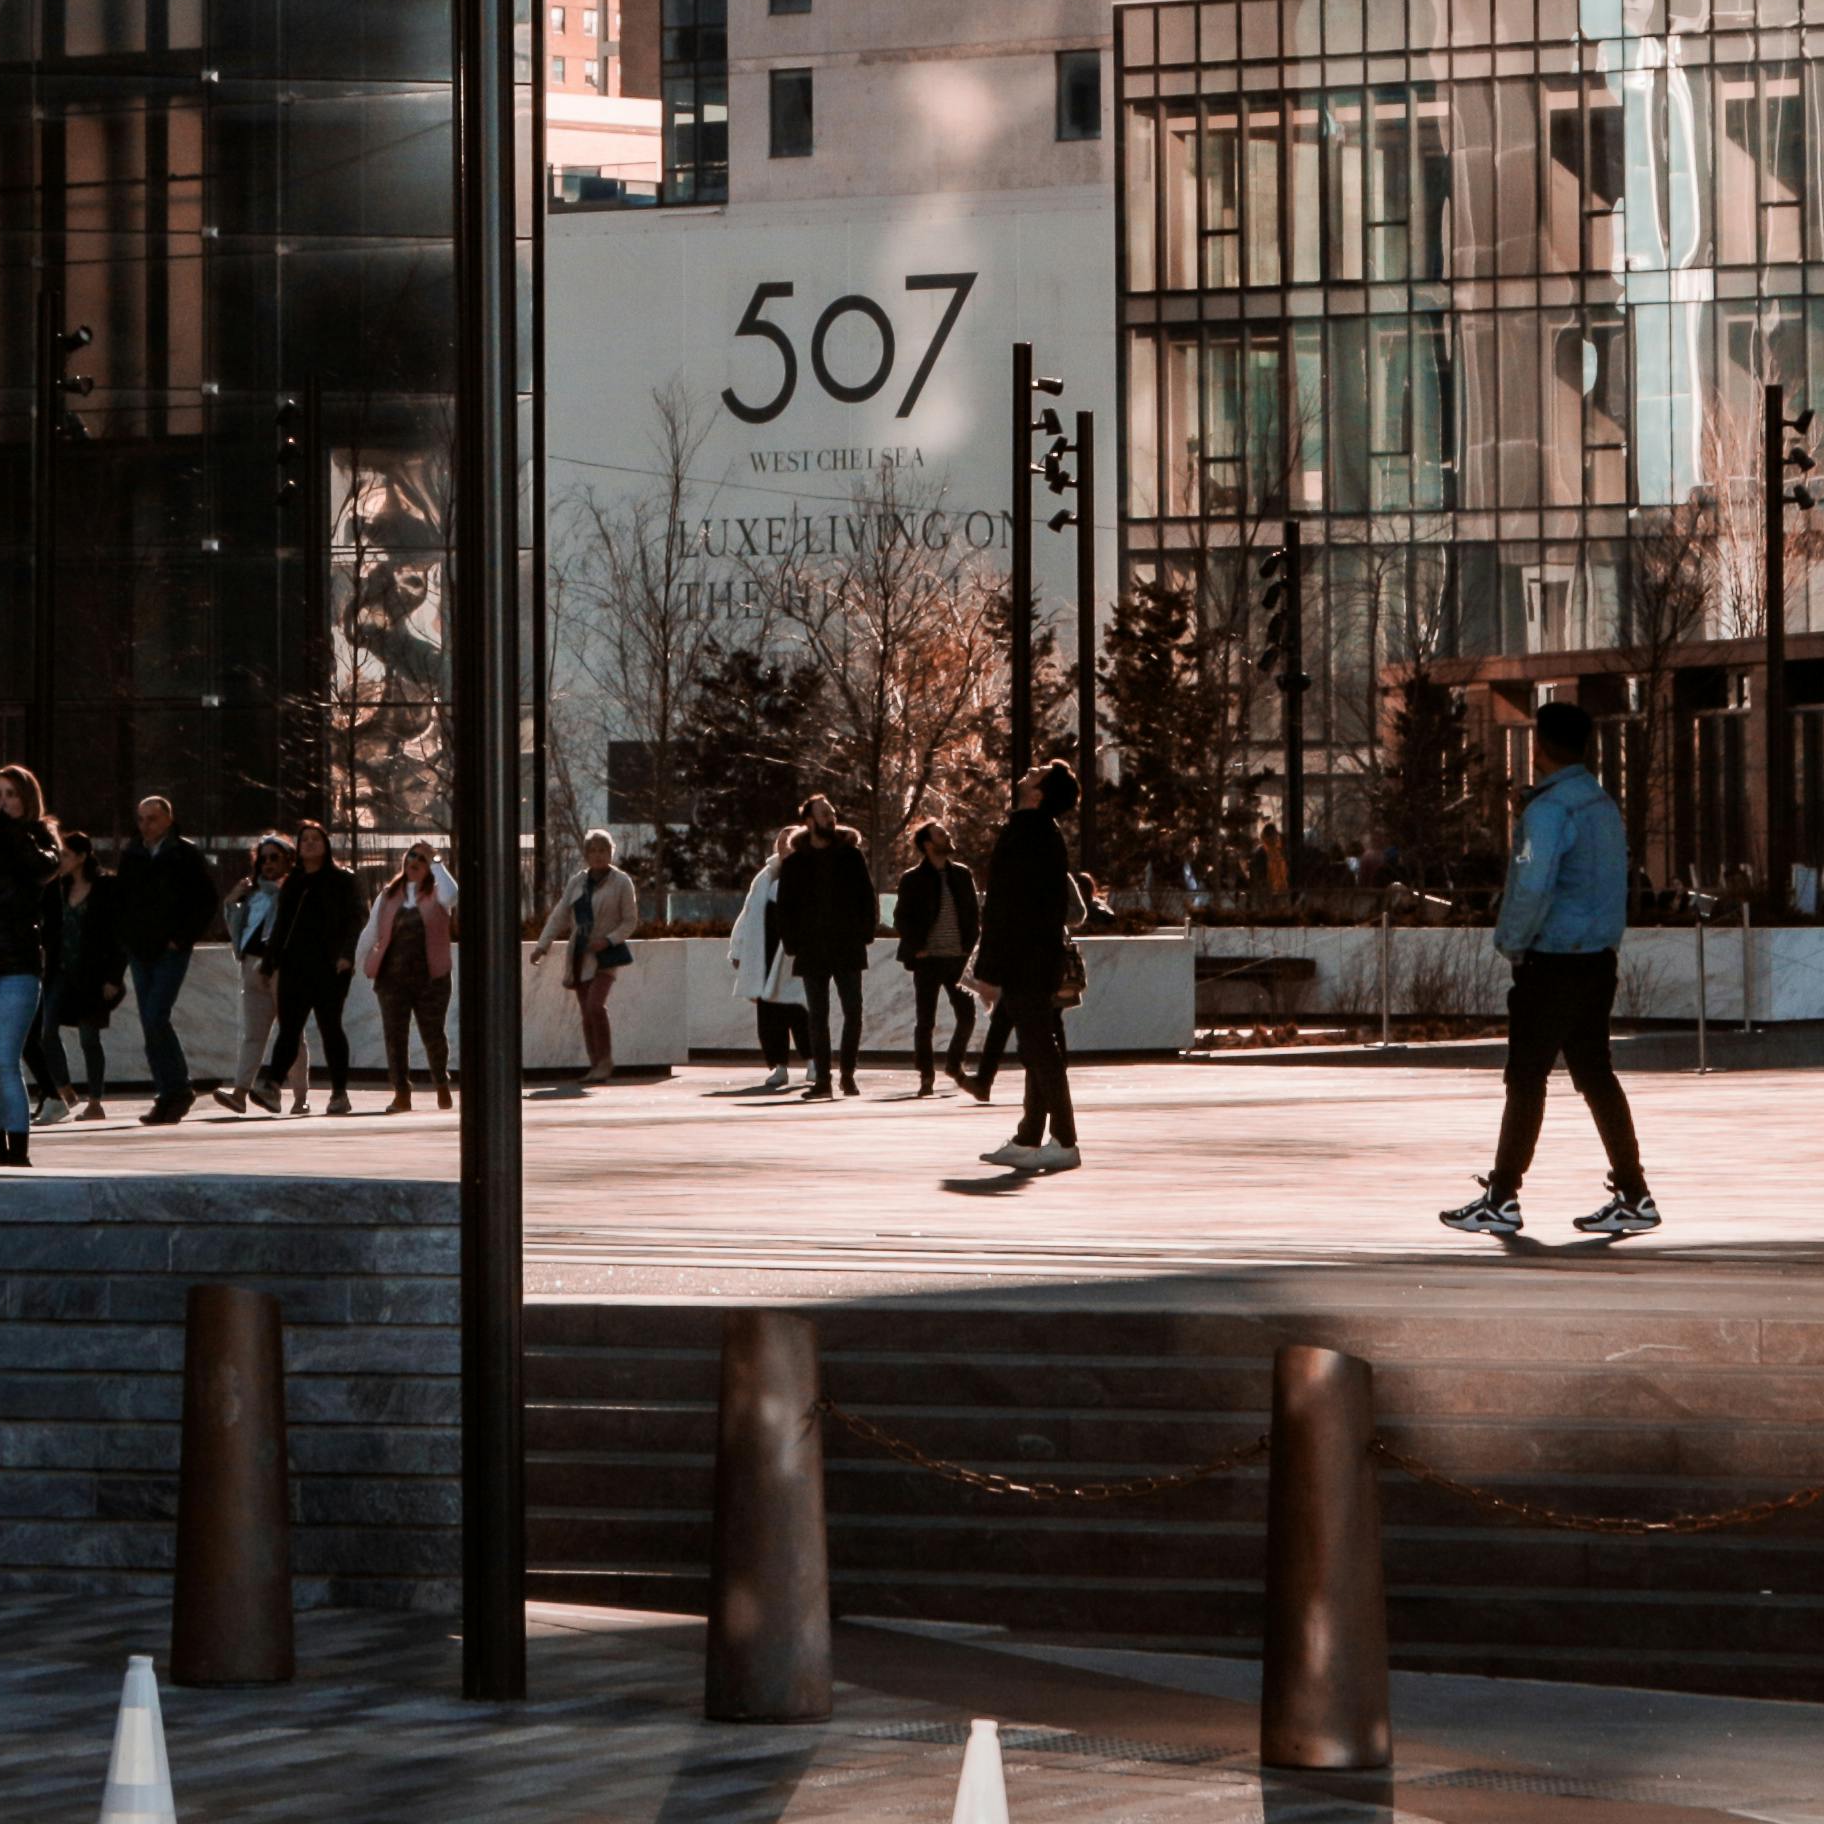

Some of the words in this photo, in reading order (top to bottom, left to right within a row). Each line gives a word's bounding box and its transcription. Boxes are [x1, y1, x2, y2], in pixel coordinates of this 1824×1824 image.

[720, 272, 979, 425] 507
[750, 449, 813, 474] WEST
[817, 446, 925, 472] CHELSEA
[678, 517, 789, 560] LUXE
[803, 511, 949, 557] LIVING
[678, 580, 764, 621] THE
